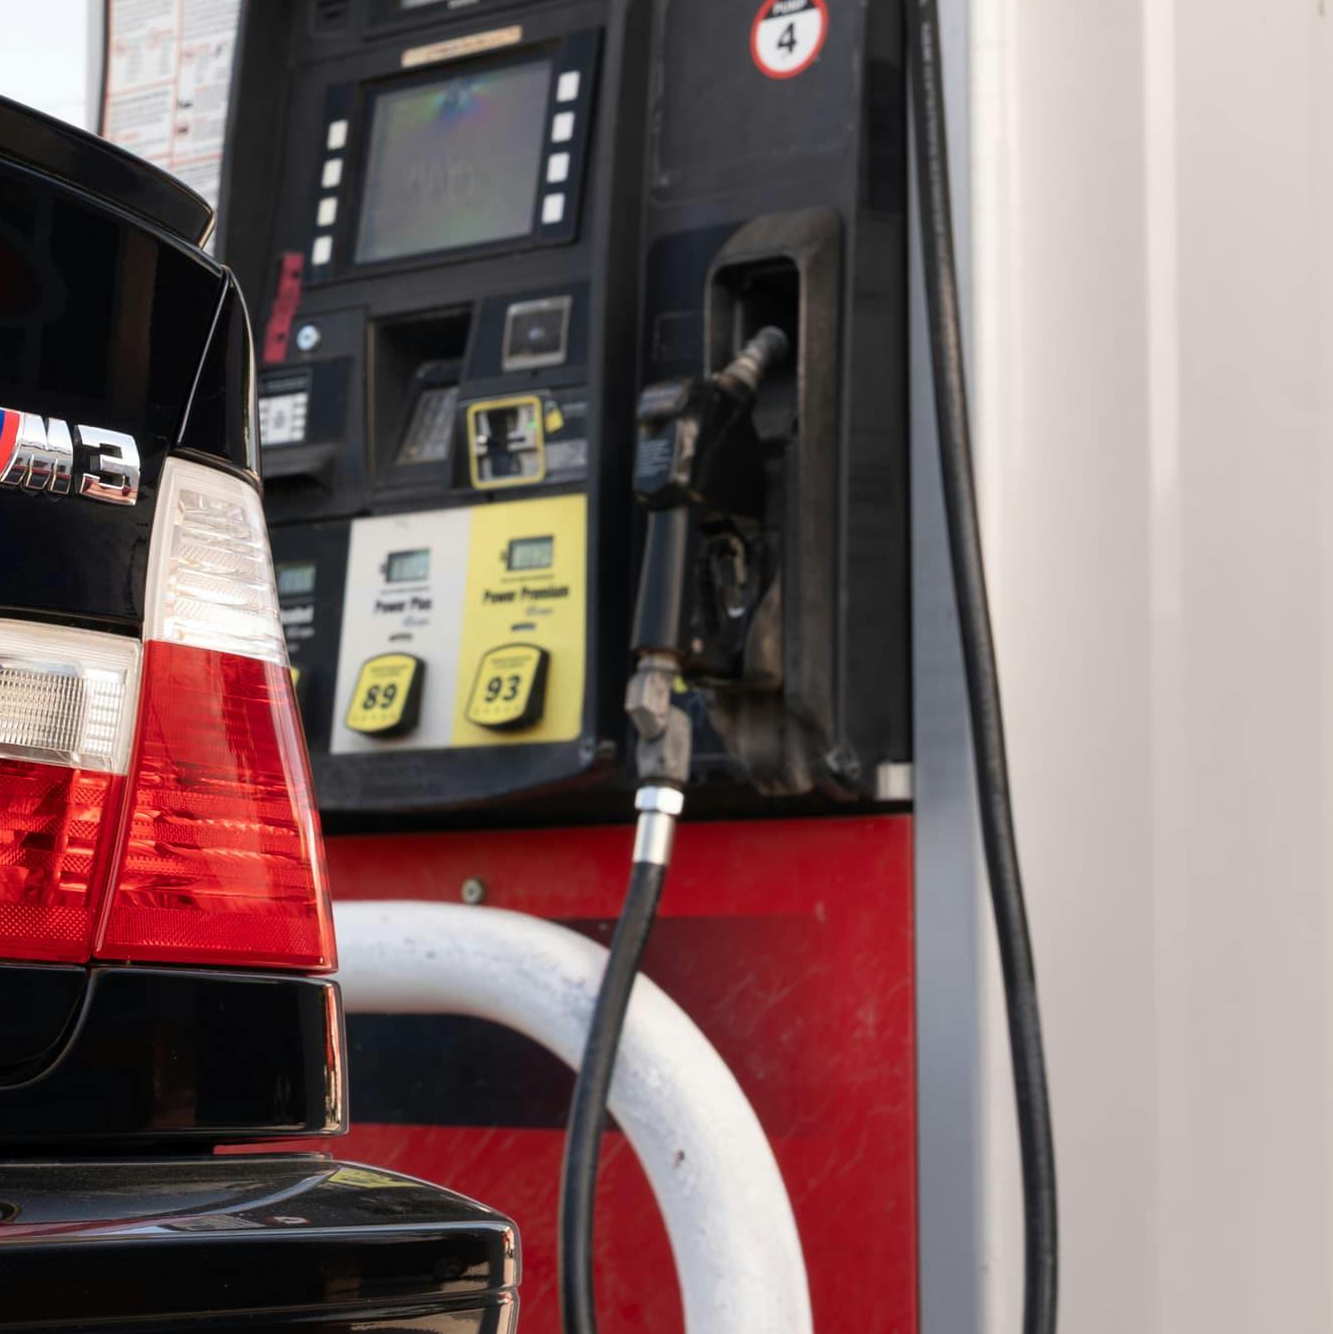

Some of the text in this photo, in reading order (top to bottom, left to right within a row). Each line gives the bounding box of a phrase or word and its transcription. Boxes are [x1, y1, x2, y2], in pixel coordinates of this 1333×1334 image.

[777, 22, 797, 53] 4
[0, 412, 141, 506] M3
[362, 682, 398, 711] 89
[484, 674, 521, 703] 93
